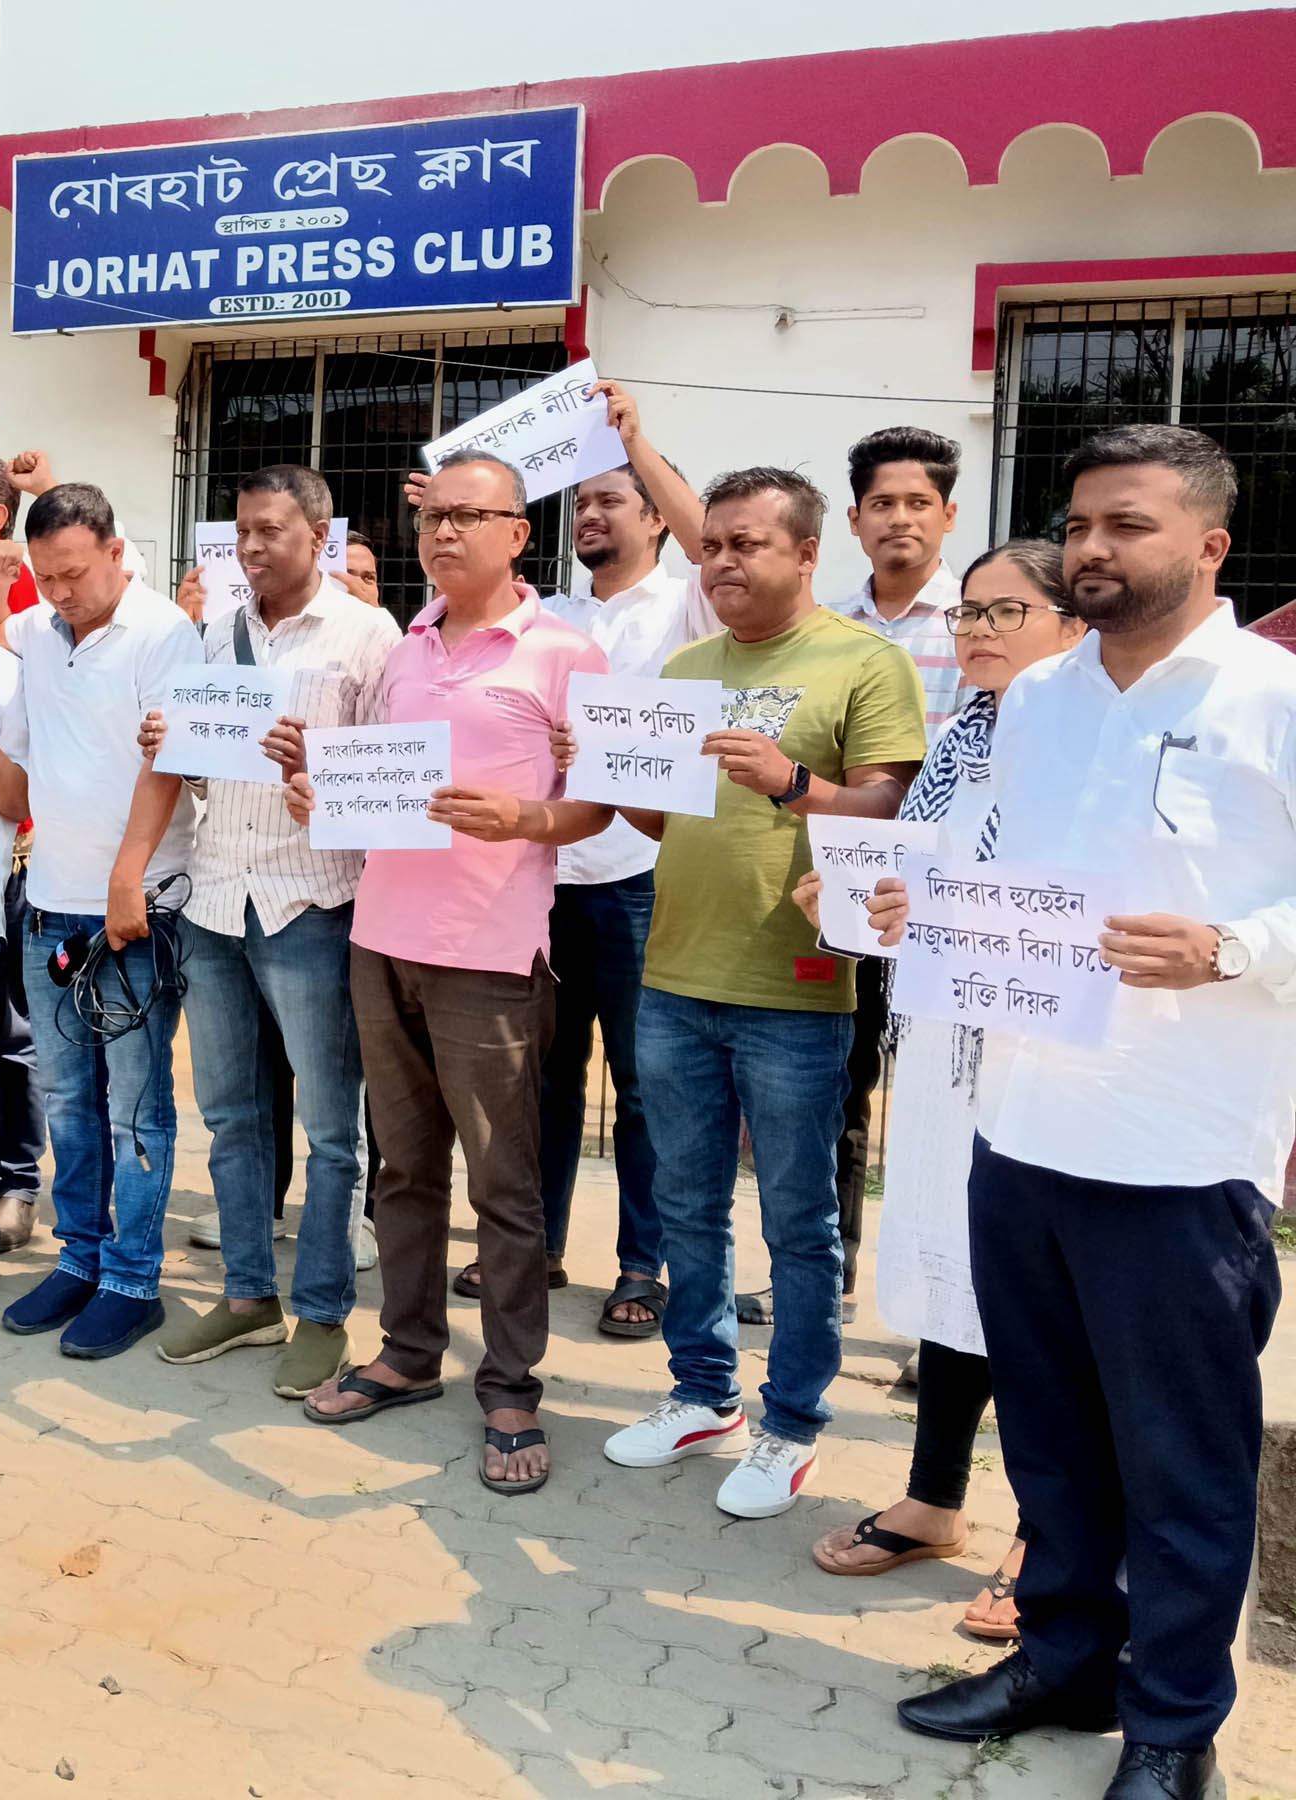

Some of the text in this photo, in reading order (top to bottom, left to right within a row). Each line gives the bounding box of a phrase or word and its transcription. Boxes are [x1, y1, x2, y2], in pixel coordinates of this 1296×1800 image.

[50, 156, 248, 219] যোৰহাট
[415, 138, 541, 191] ক্লাব
[220, 215, 272, 234] স্থাপিত
[296, 213, 342, 228] ২০০১
[35, 224, 553, 300] JORHAT PRESS CLUB
[292, 291, 343, 309] 2001
[173, 684, 231, 705] সাংবাদিক
[189, 721, 210, 739] বন্ধ
[583, 704, 632, 728] অসম
[640, 702, 695, 738] পুলিচ
[388, 739, 426, 756] সংবাদ
[421, 769, 444, 783] এক
[822, 841, 887, 868] সাংবাদিক
[1019, 928, 1063, 967] বিনা
[952, 972, 1060, 1018] মুক্তি দিয়ক
